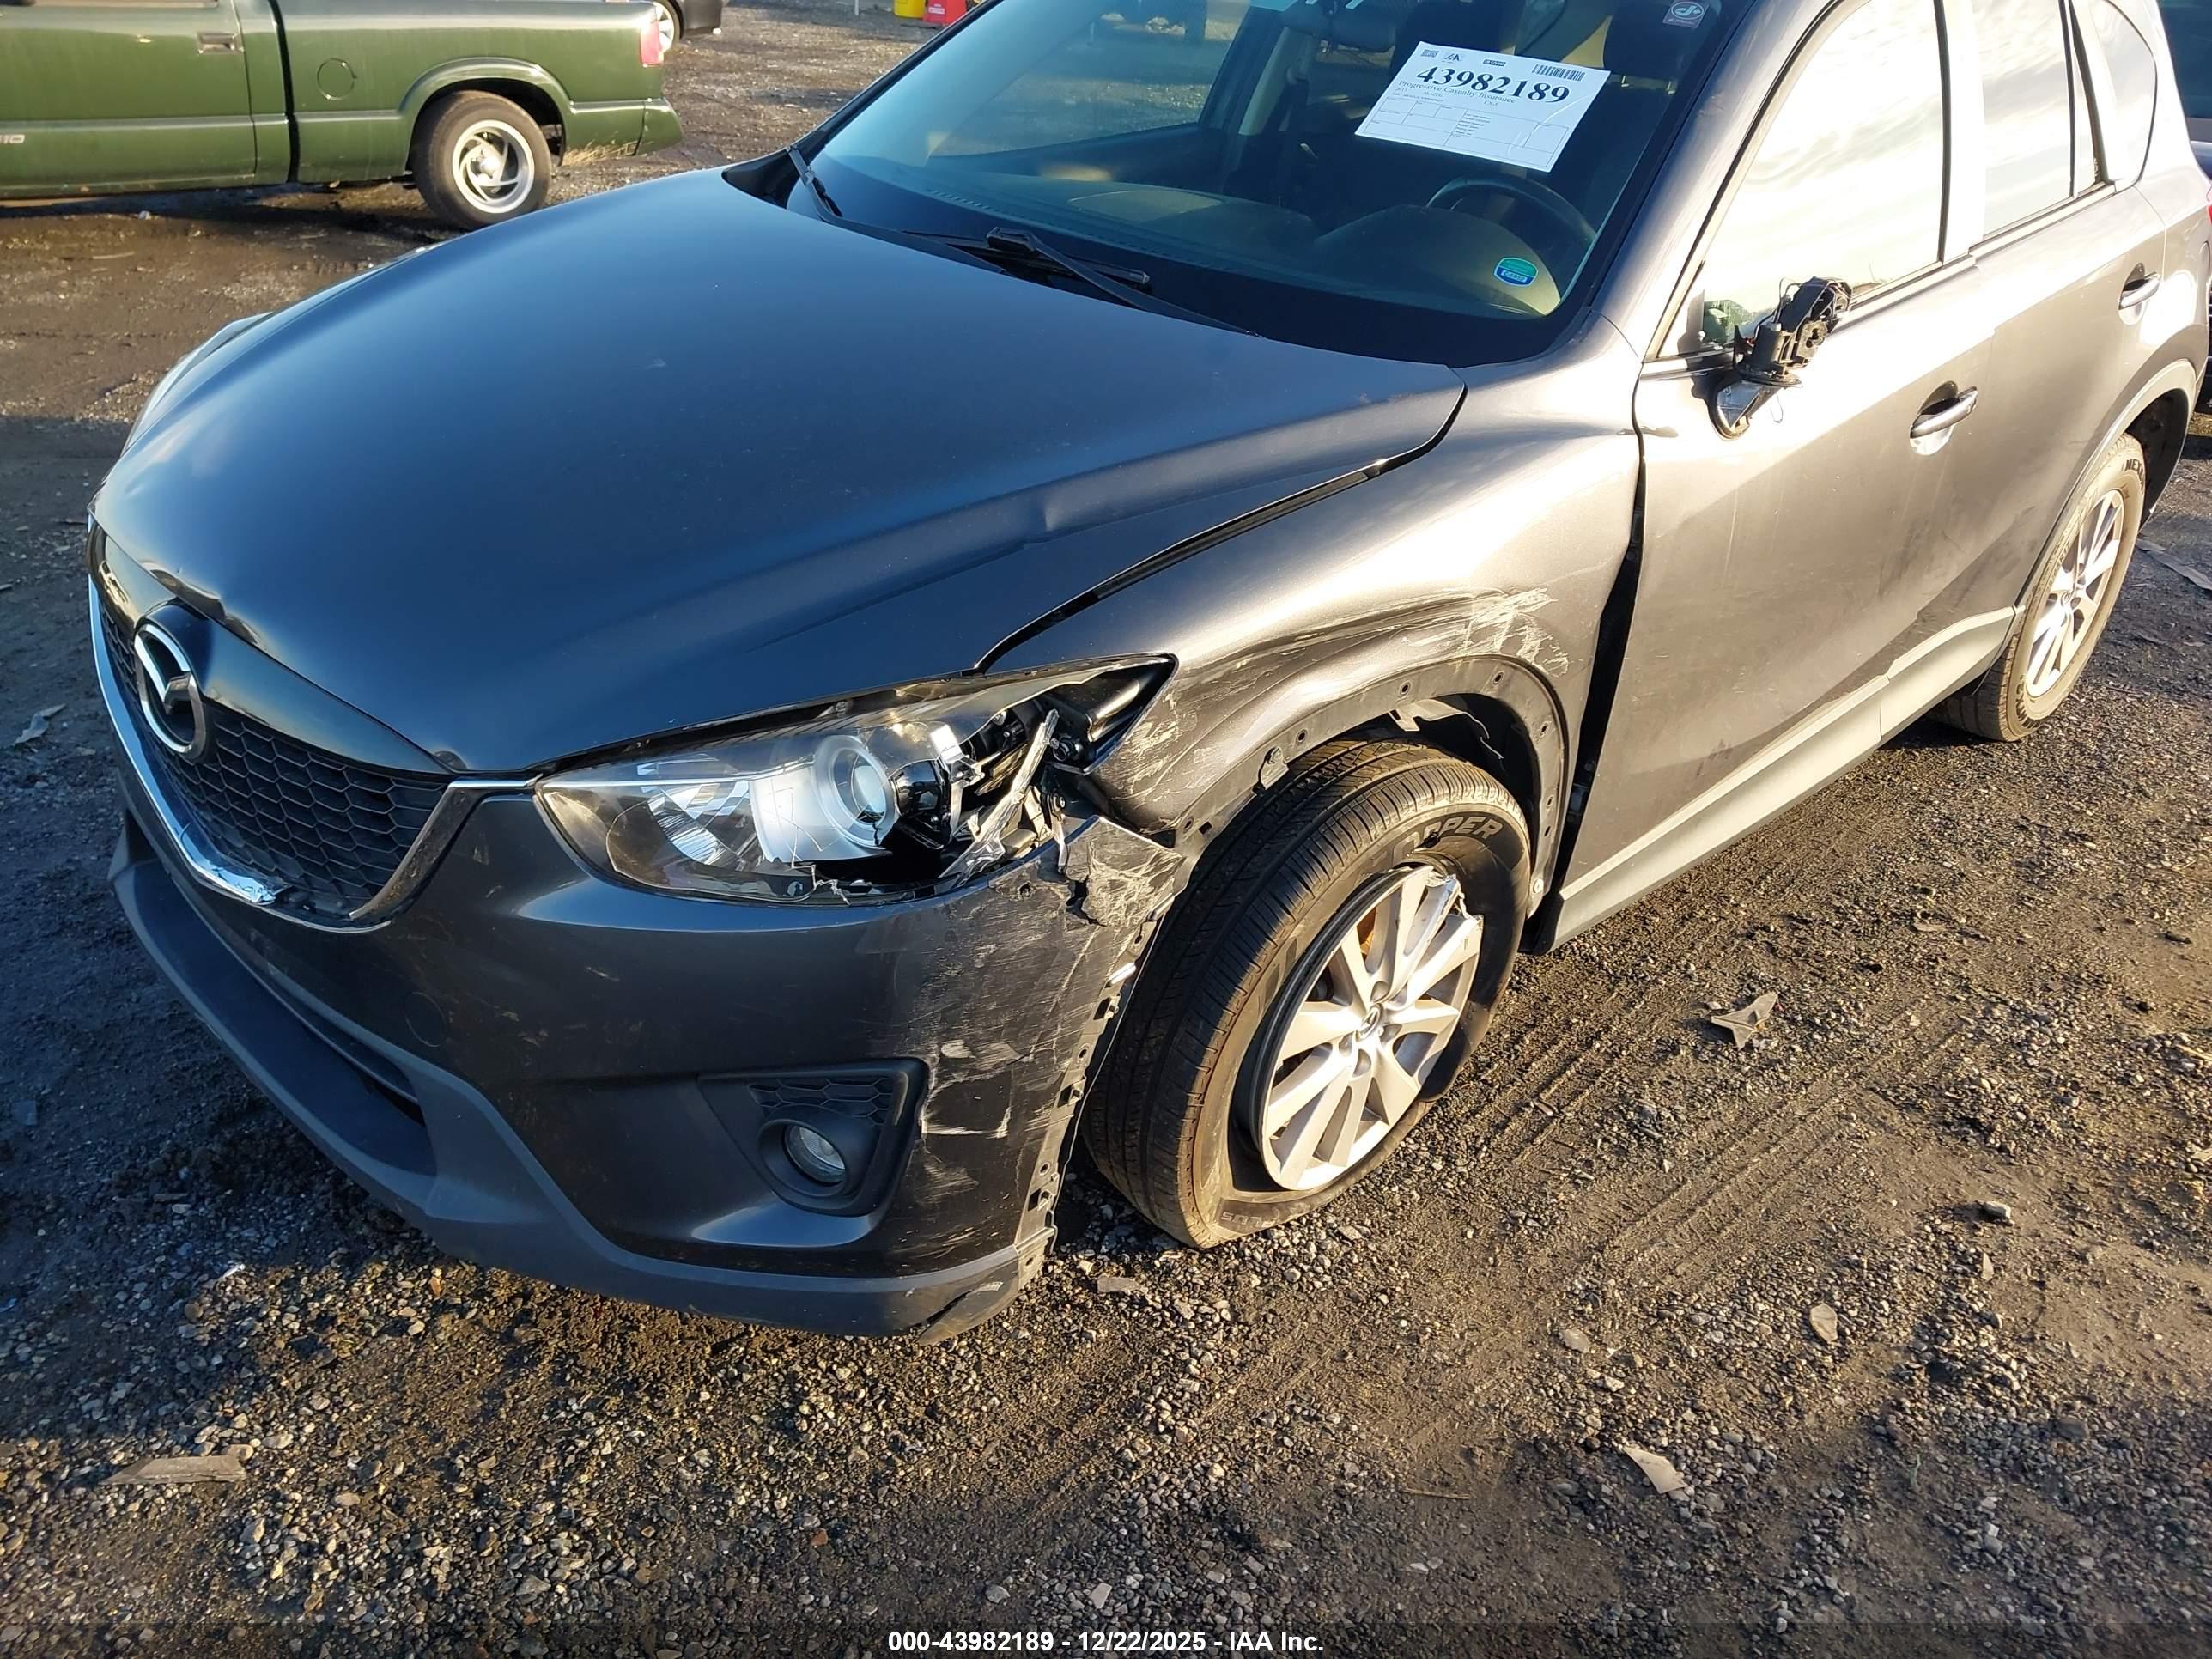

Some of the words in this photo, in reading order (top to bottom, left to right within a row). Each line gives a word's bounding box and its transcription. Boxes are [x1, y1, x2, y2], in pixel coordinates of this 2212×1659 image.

[1399, 80, 1442, 92] Progressive
[1443, 86, 1478, 97] Casualty
[1479, 92, 1516, 104] Insurance
[1417, 66, 1570, 103] 43982189
[0, 134, 26, 144] 10
